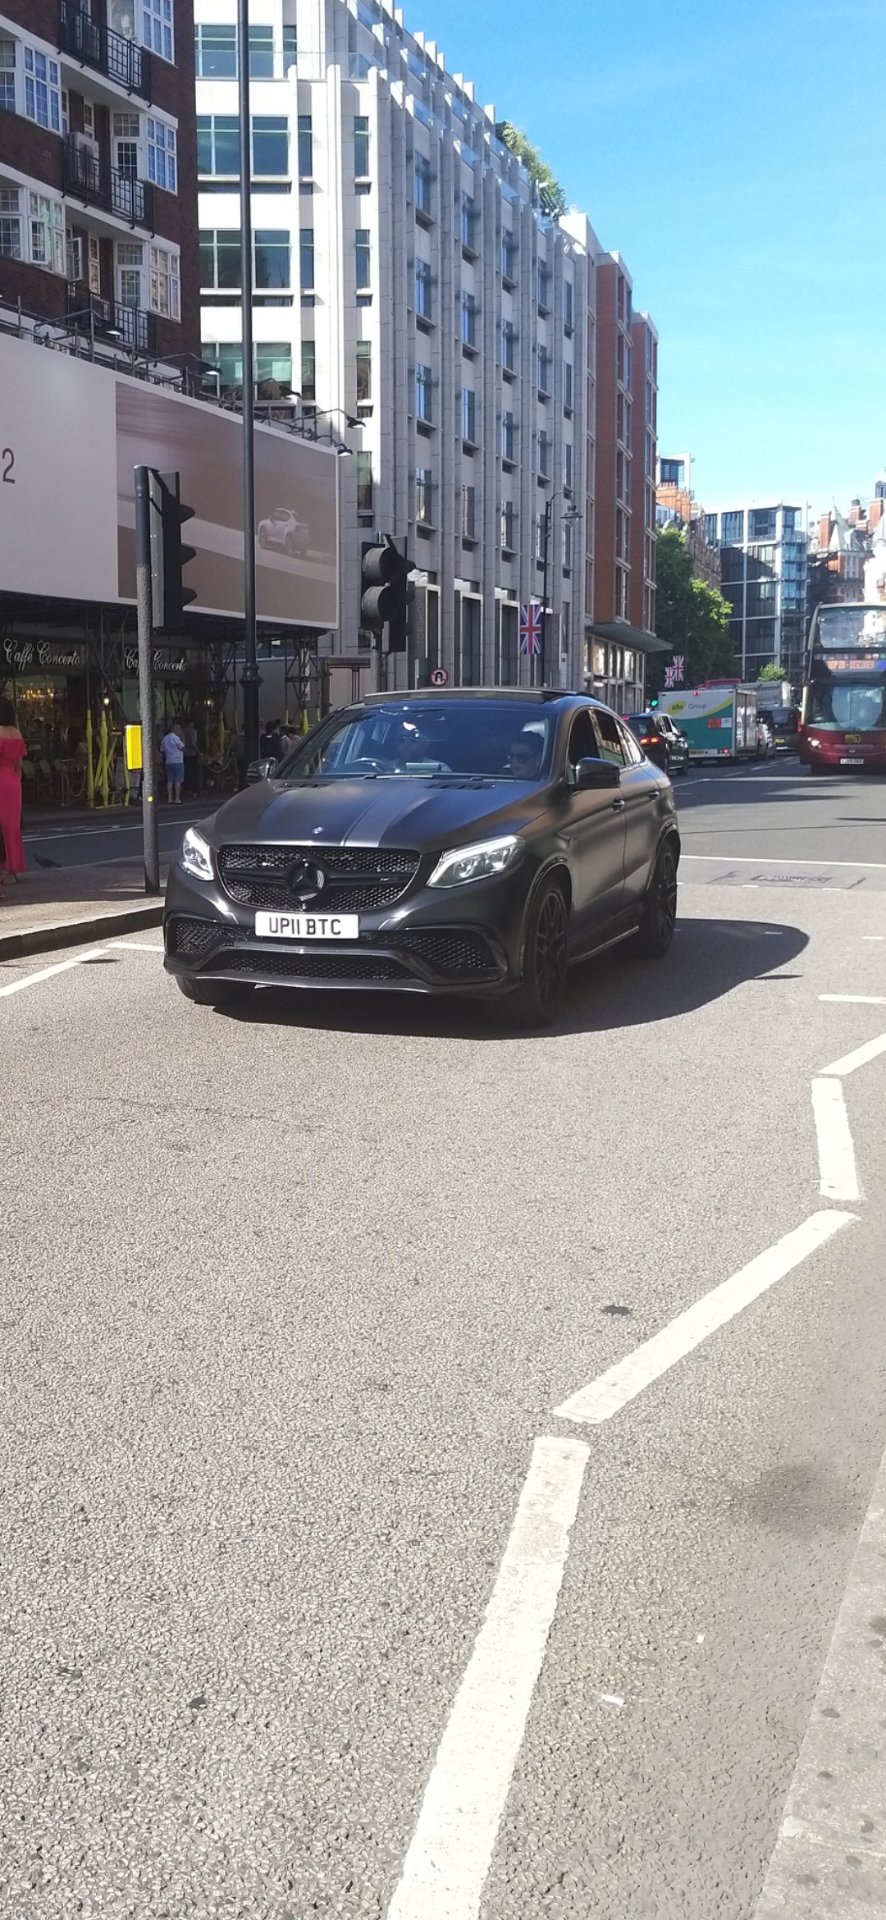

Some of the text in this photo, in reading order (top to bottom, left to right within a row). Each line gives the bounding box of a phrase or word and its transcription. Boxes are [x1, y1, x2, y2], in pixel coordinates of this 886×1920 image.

[2, 447, 16, 484] 2
[36, 640, 81, 665] Concerto
[151, 647, 187, 672] Concerto
[269, 916, 342, 936] UP11 BTC
